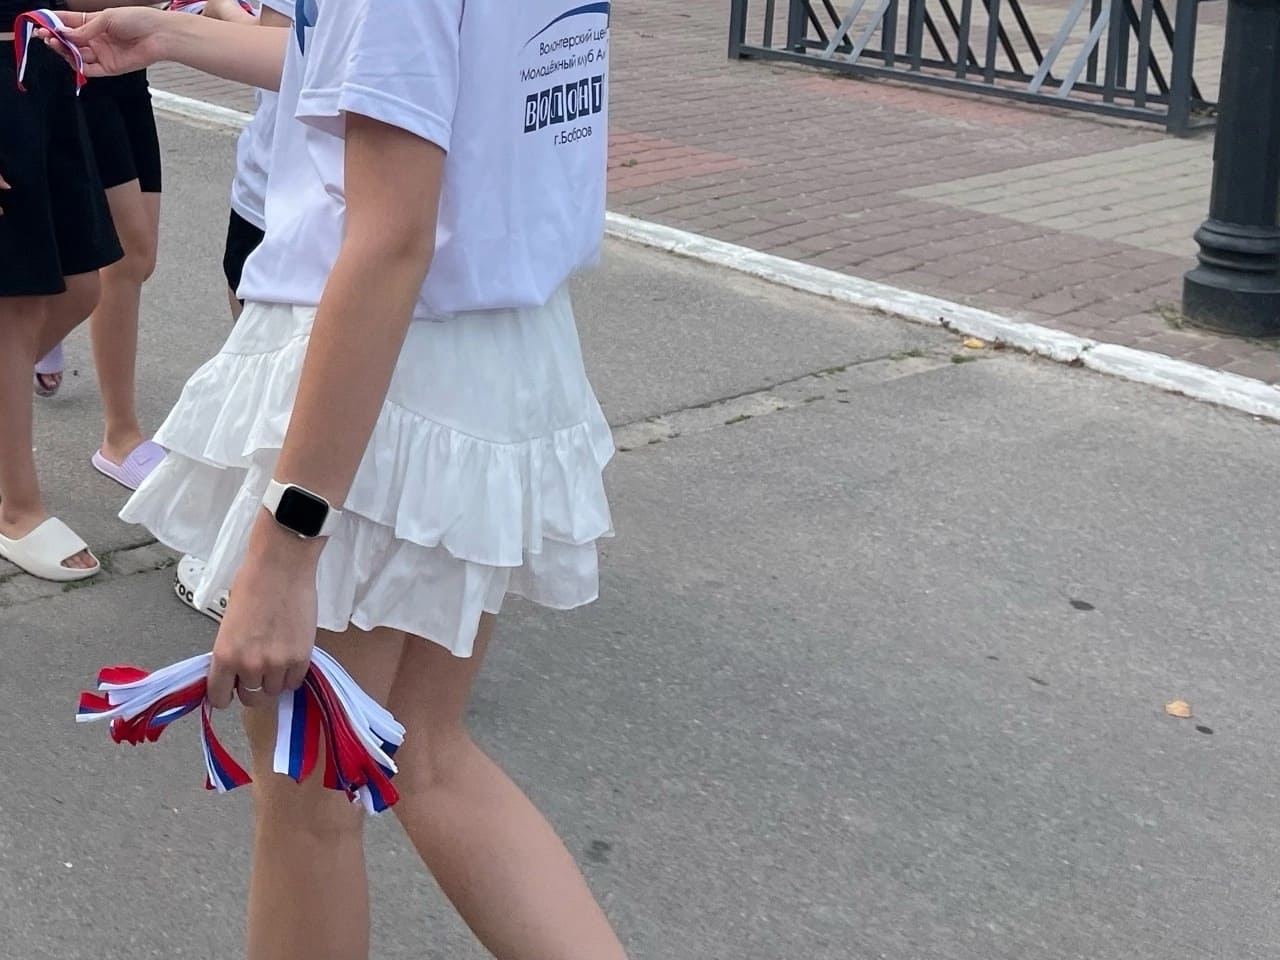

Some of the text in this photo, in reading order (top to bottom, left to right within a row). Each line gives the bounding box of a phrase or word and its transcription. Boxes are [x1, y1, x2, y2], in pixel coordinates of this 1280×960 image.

[593, 28, 606, 41] це
[577, 48, 594, 67] клуб
[524, 74, 605, 134] ВОЛОНТ
[553, 125, 593, 145] г.Бобров
